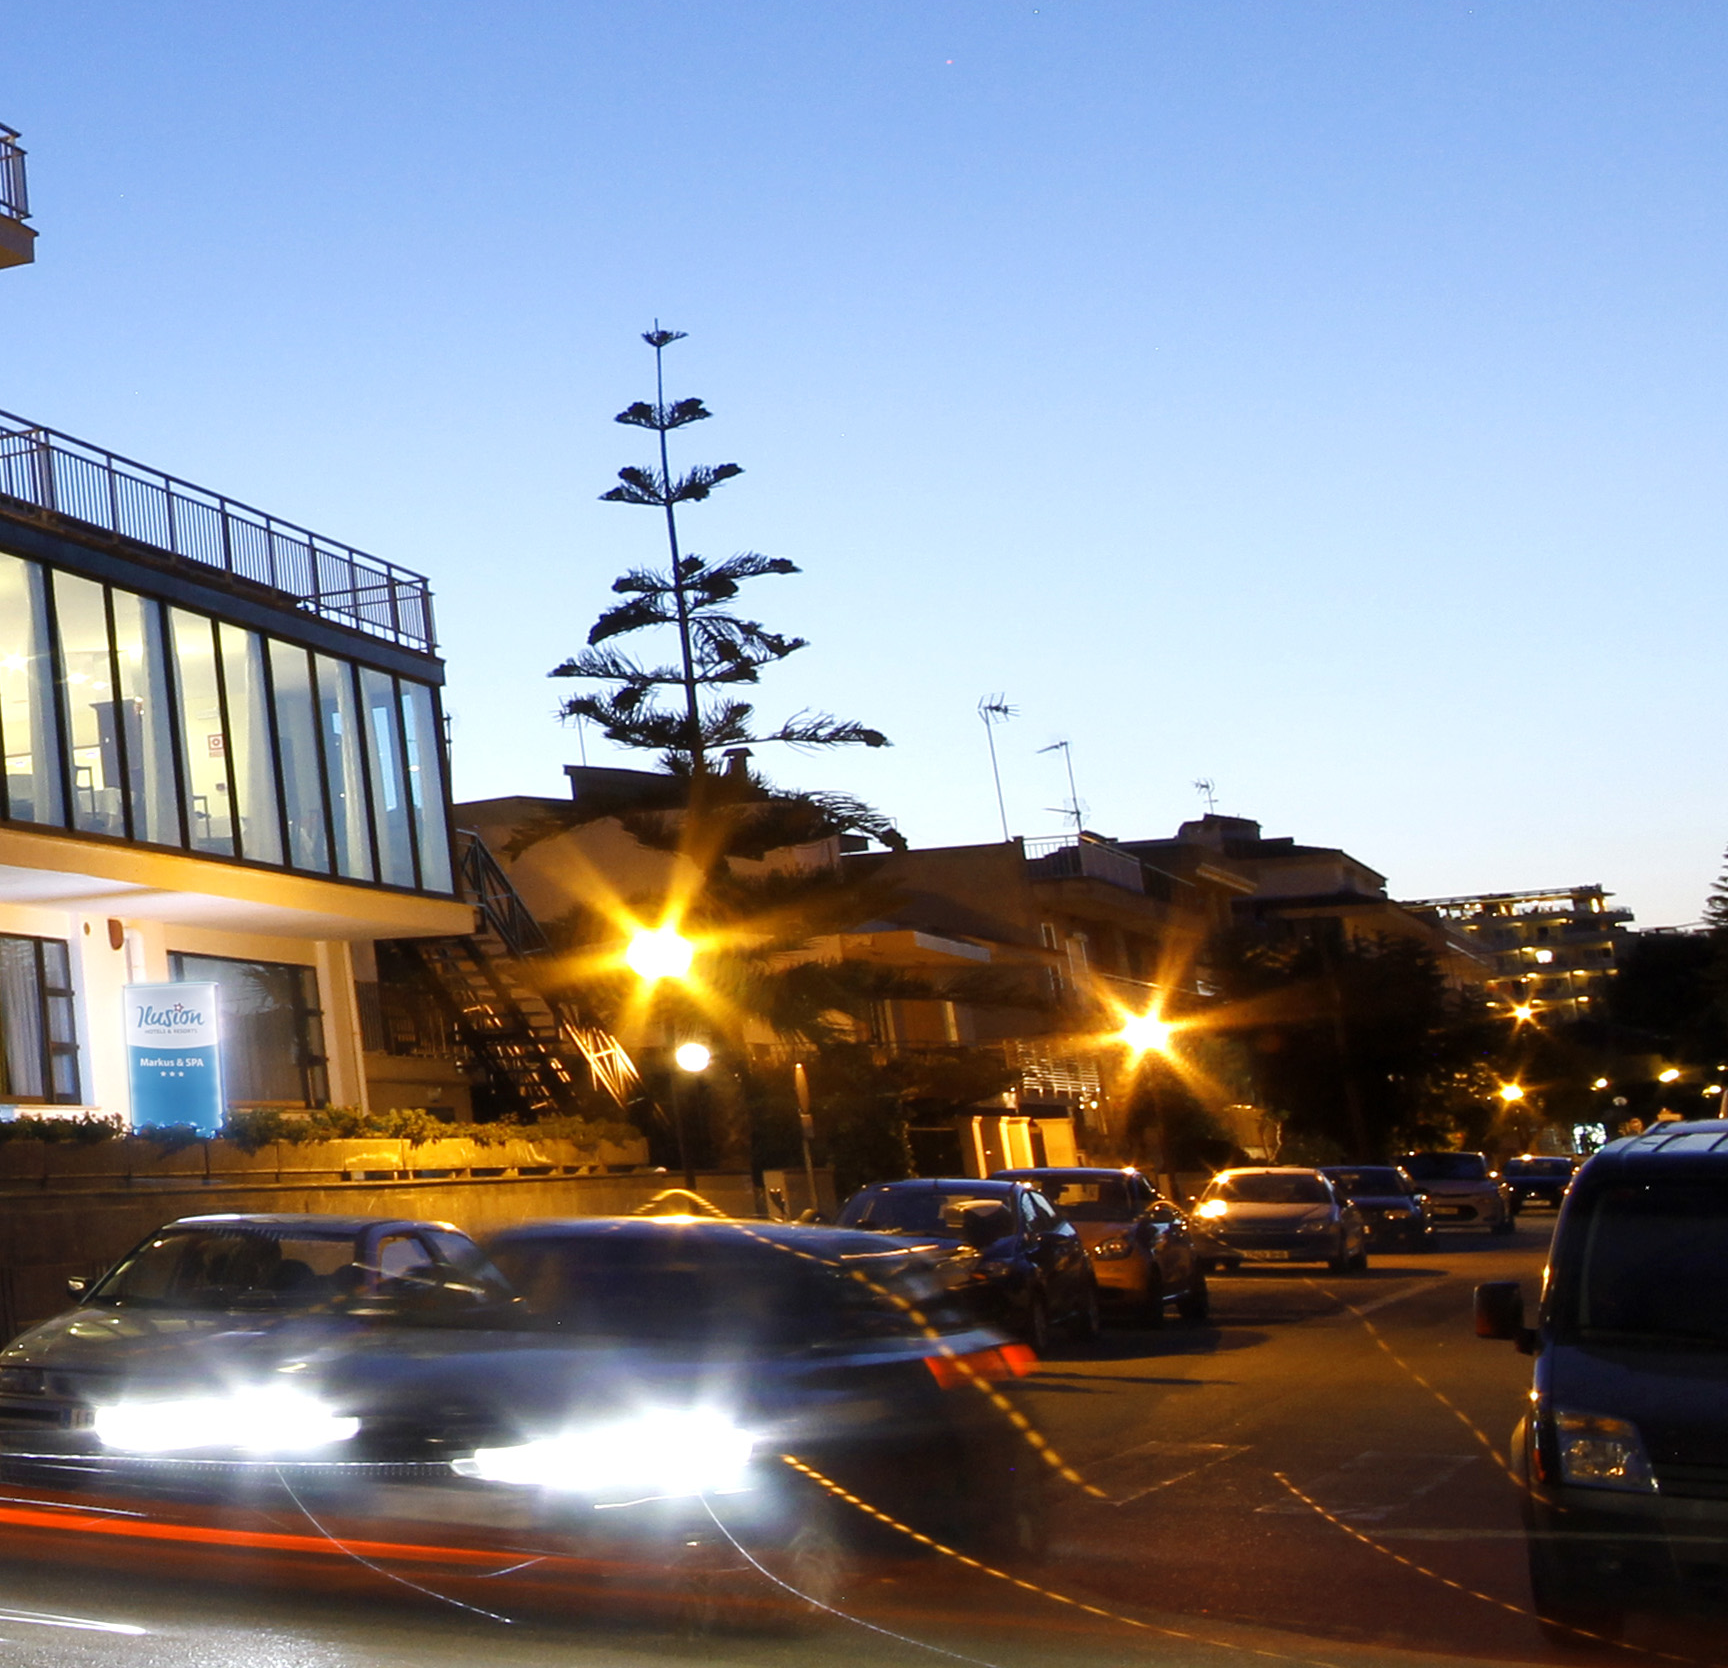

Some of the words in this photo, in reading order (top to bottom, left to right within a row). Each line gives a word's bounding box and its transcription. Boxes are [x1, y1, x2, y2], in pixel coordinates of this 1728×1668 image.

[136, 1003, 204, 1028] Ilusion
[140, 1058, 175, 1067] Markus
[176, 1058, 184, 1067] &
[185, 1058, 204, 1067] SPA
